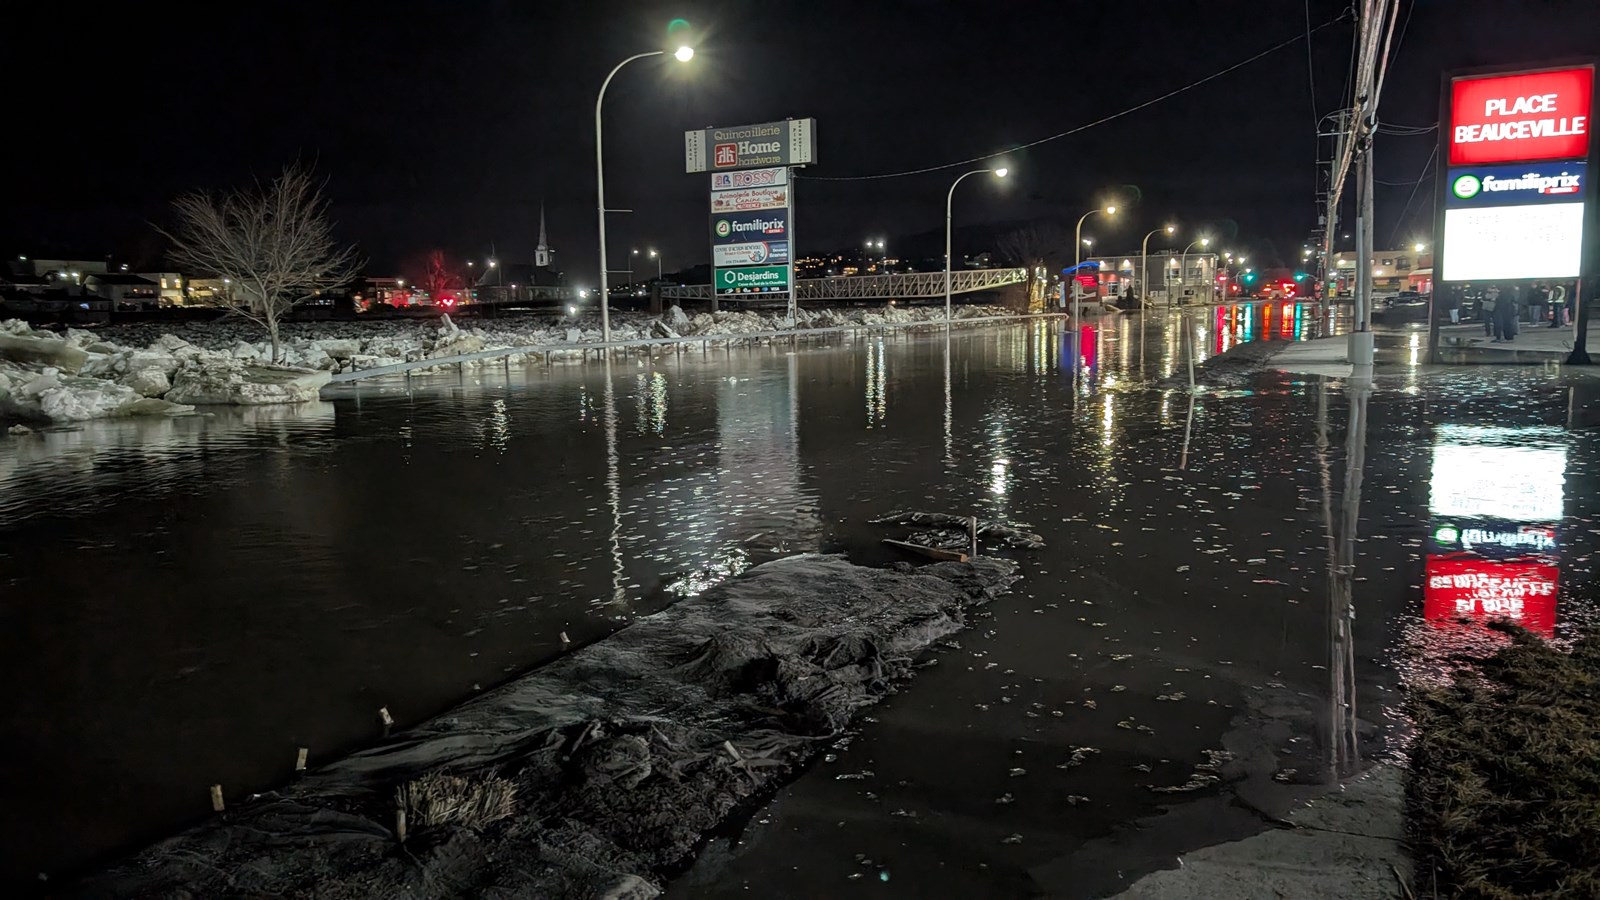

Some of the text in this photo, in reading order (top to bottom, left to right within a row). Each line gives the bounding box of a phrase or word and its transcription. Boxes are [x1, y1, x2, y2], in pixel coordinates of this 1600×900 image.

[1484, 93, 1558, 117] PLACE
[714, 127, 780, 140] Quincaillerie
[1454, 116, 1586, 144] BEAUCEVILLE
[738, 141, 780, 155] Home
[738, 156, 781, 166] hardware
[733, 169, 783, 187] ROSSY
[1481, 171, 1580, 194] familiprix
[751, 189, 778, 197] Boutique
[732, 219, 784, 233] familiprix
[738, 271, 779, 281] Desjardins
